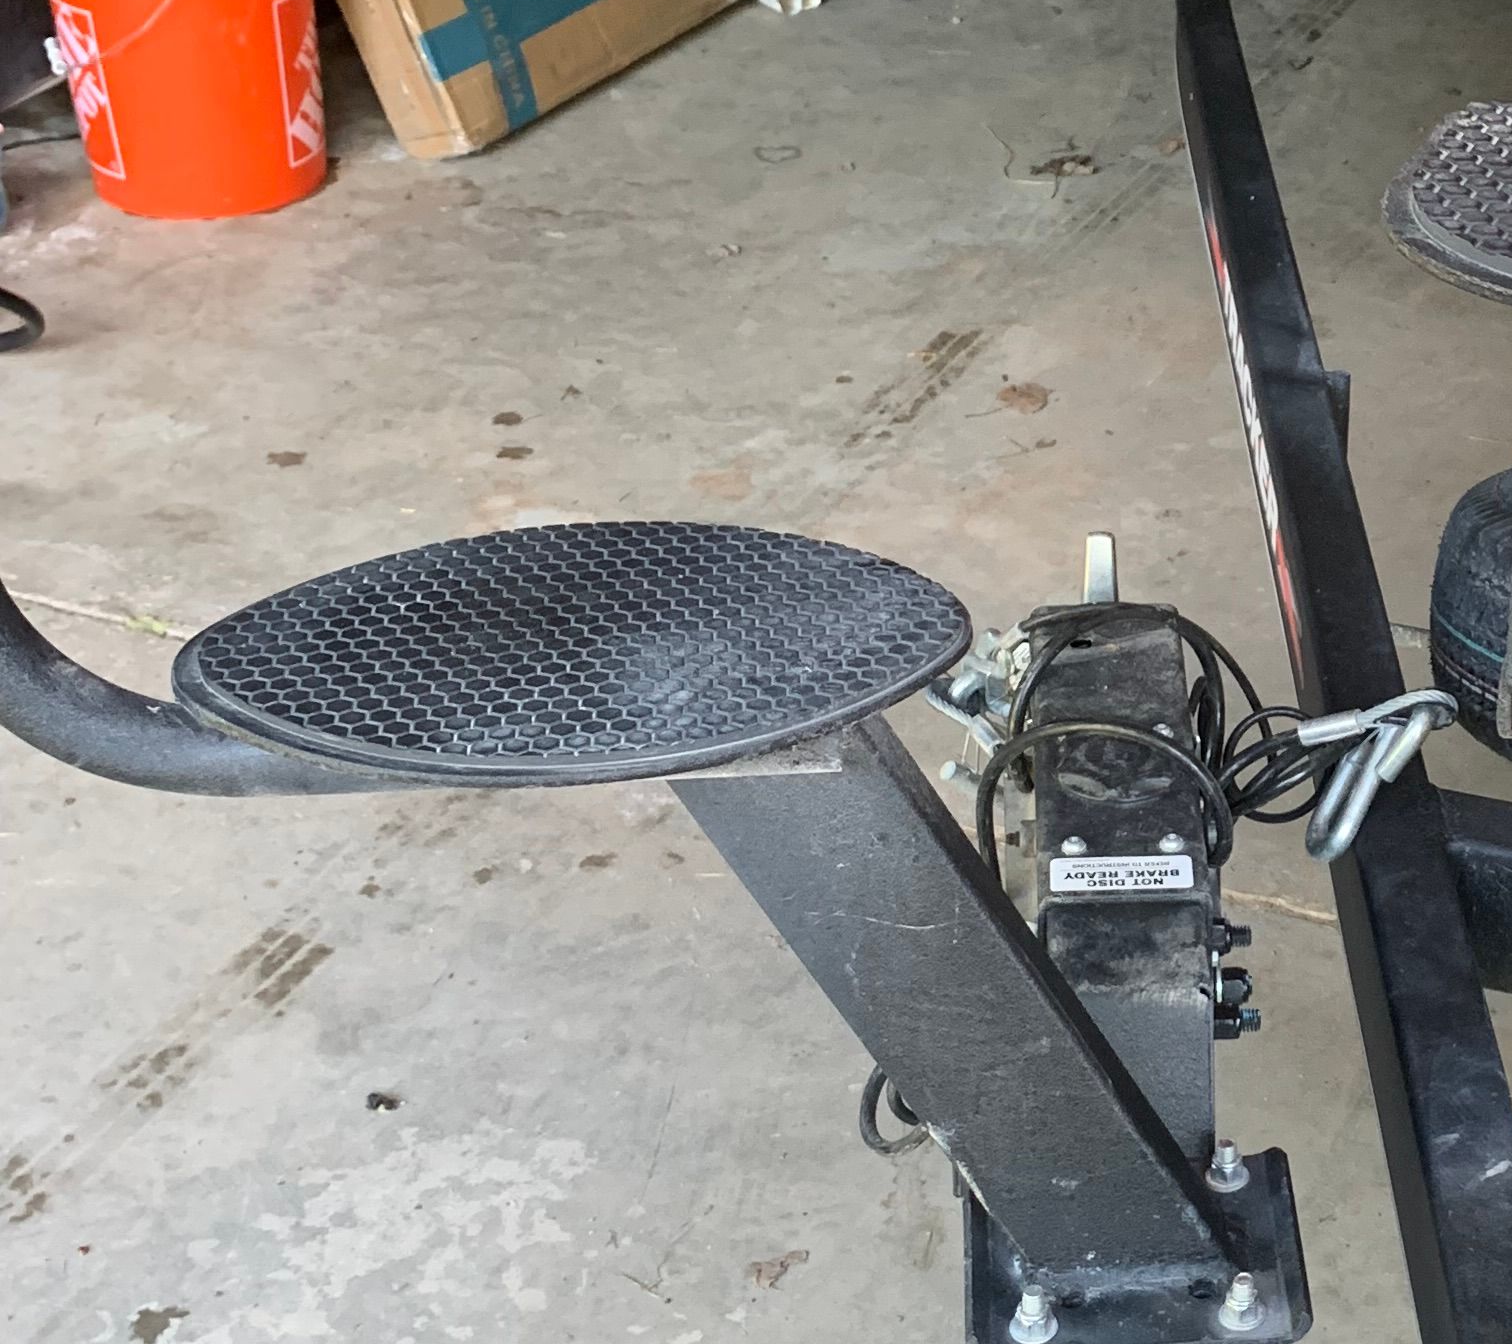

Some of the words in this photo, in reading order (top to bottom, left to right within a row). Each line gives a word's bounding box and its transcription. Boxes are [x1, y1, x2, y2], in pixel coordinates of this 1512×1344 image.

[480, 6, 497, 29] IN
[1064, 870, 1119, 879] READY
[1124, 868, 1180, 878] BRAKE
[1087, 879, 1126, 887] DISC
[1132, 877, 1164, 885] NOT
